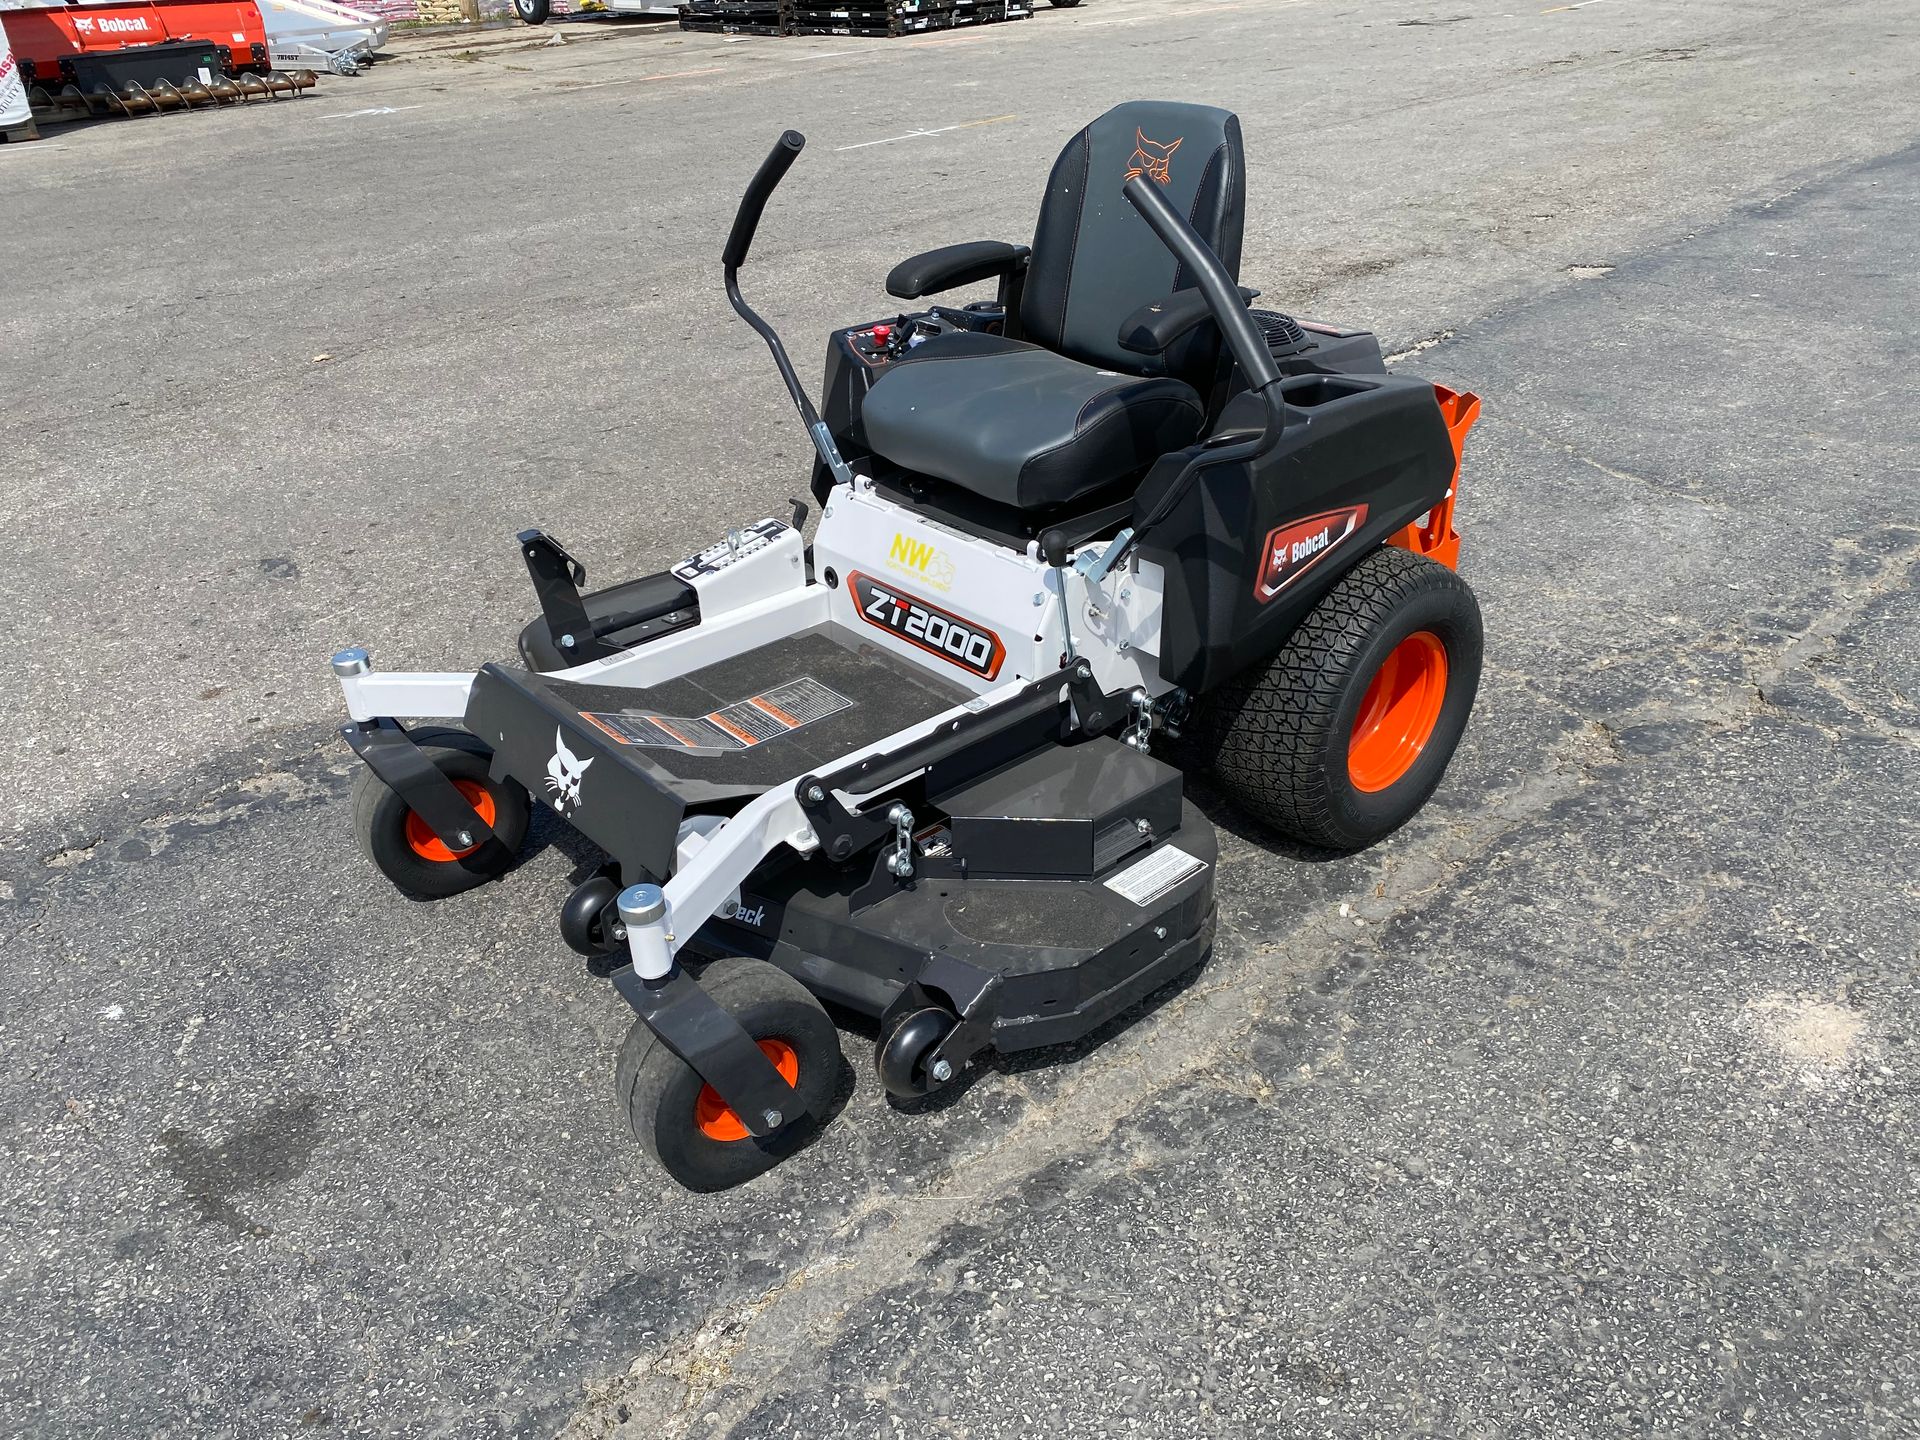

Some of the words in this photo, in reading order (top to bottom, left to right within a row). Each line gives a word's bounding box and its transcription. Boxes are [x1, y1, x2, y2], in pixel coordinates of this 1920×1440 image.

[97, 16, 149, 33] Bobcat
[889, 532, 935, 572] NW
[1291, 526, 1329, 564] Bobcat
[865, 587, 993, 668] ZT2000
[735, 905, 766, 927] eck
